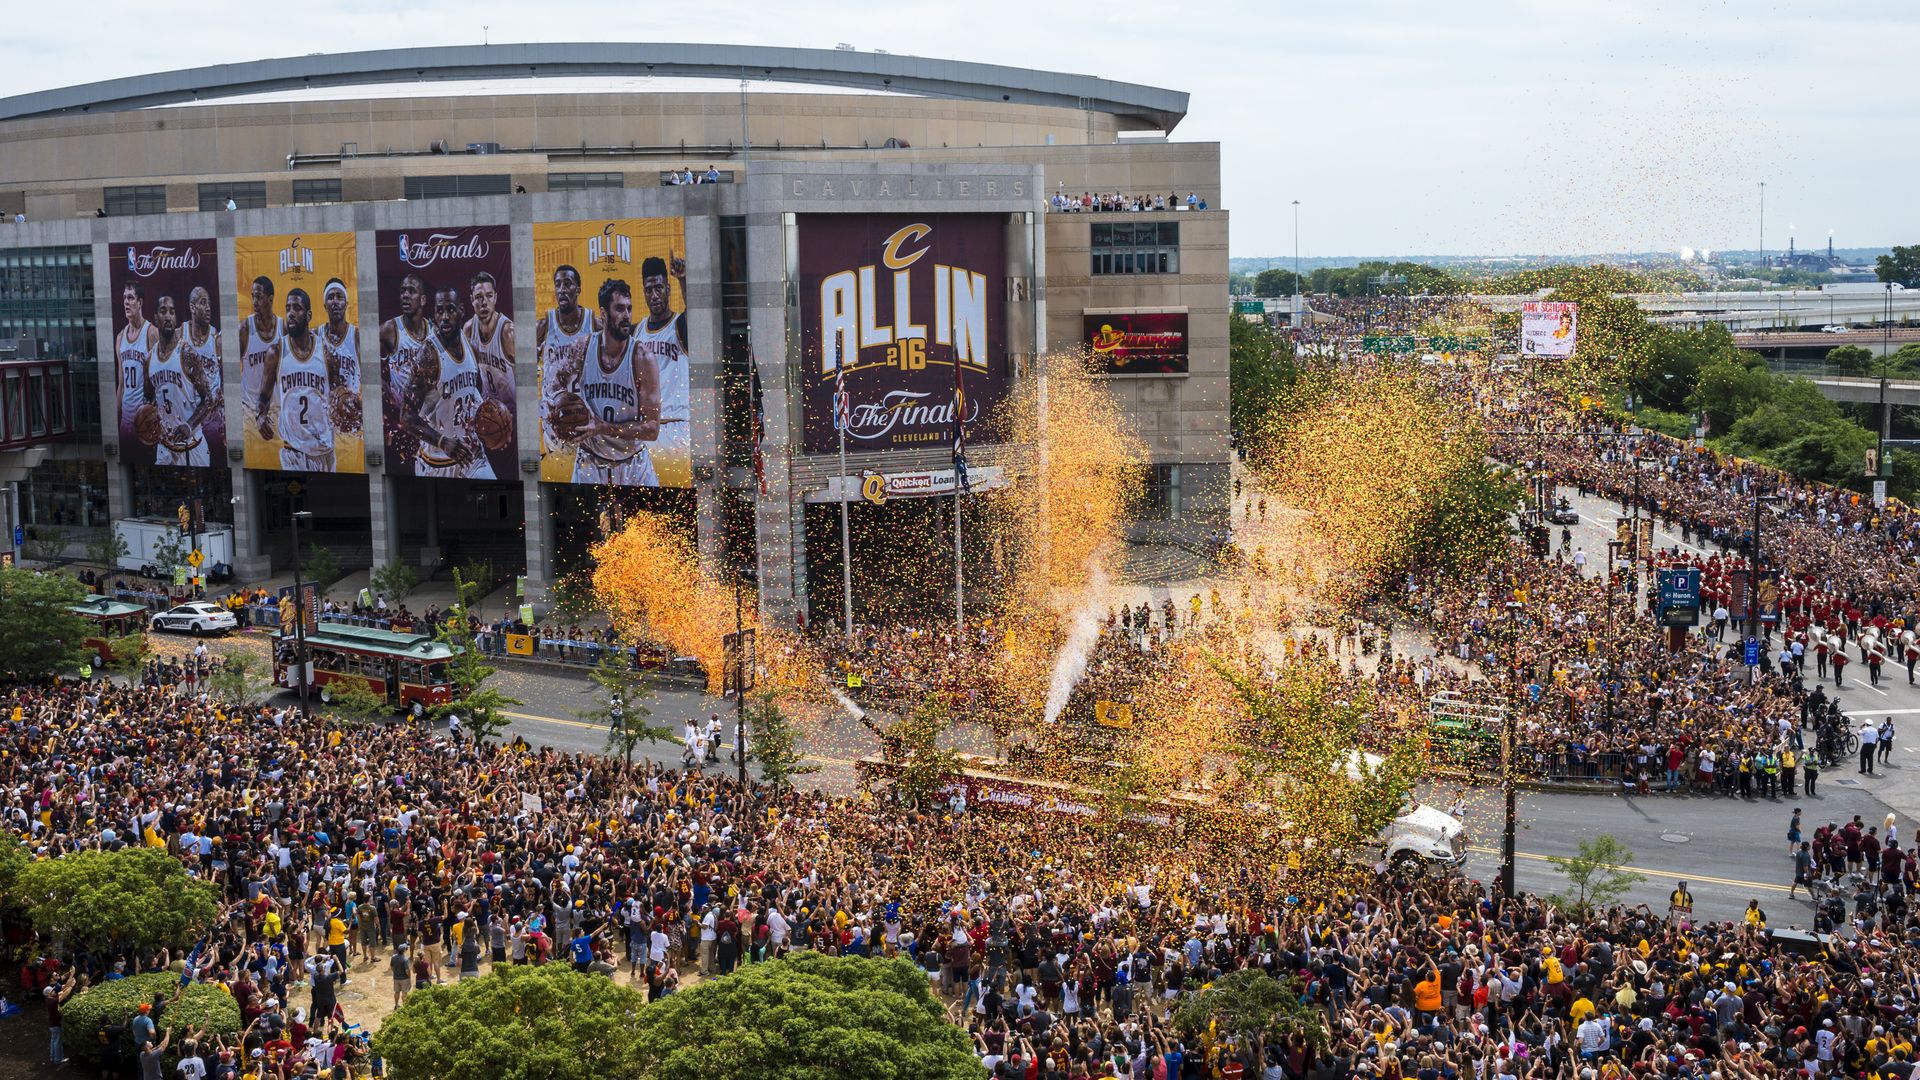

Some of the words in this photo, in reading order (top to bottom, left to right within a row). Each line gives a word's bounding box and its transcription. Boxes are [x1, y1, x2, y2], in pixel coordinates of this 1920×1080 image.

[792, 179, 1024, 196] CAVALIERS
[136, 253, 154, 270] The
[146, 245, 200, 277] Finals
[279, 247, 301, 274] ALL
[301, 247, 314, 274] IN
[409, 241, 433, 260] The
[422, 233, 489, 267] Finals
[588, 235, 615, 265] ALL
[616, 234, 631, 265] IN
[821, 265, 928, 374] ALL
[934, 263, 988, 368] IN
[125, 367, 136, 388] 20
[281, 372, 325, 394] CAVALIERS
[162, 389, 172, 414] 5
[584, 383, 635, 407] CAVALIERS
[299, 396, 309, 425] 2
[850, 402, 889, 428] The
[892, 432, 940, 442] CLEVELAND
[891, 477, 930, 488] Quicken
[933, 475, 955, 485] Loan
[1678, 577, 1685, 588] P
[575, 943, 583, 952] 5
[1822, 1040, 1827, 1049] 2
[184, 1064, 195, 1075] 23
